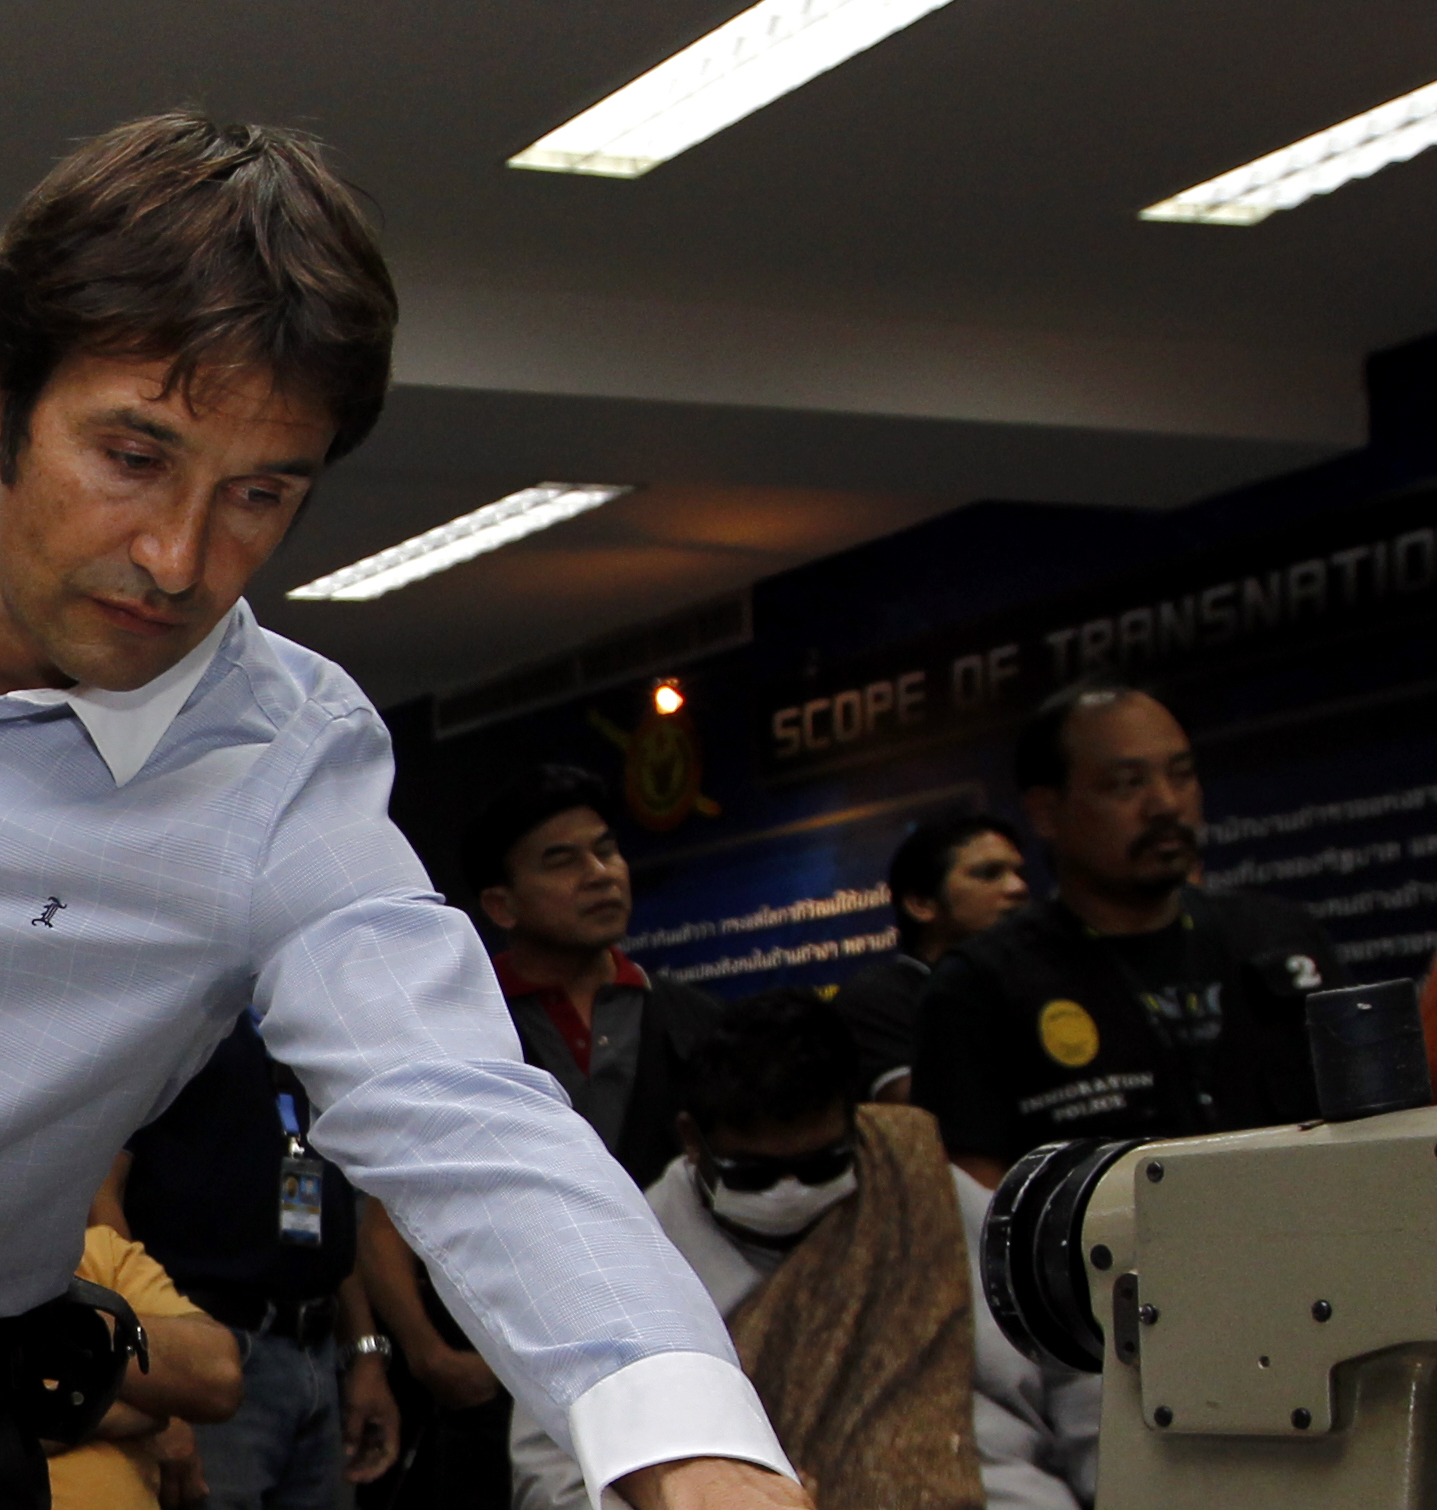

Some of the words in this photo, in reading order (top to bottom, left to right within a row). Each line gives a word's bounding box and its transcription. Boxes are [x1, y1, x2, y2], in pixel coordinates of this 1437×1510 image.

[770, 670, 926, 757] SCOPE
[950, 643, 1021, 712] OF
[1286, 955, 1322, 989] 2
[1017, 1070, 1155, 1117] IMMIGRATION
[1051, 1092, 1127, 1124] POLICE
